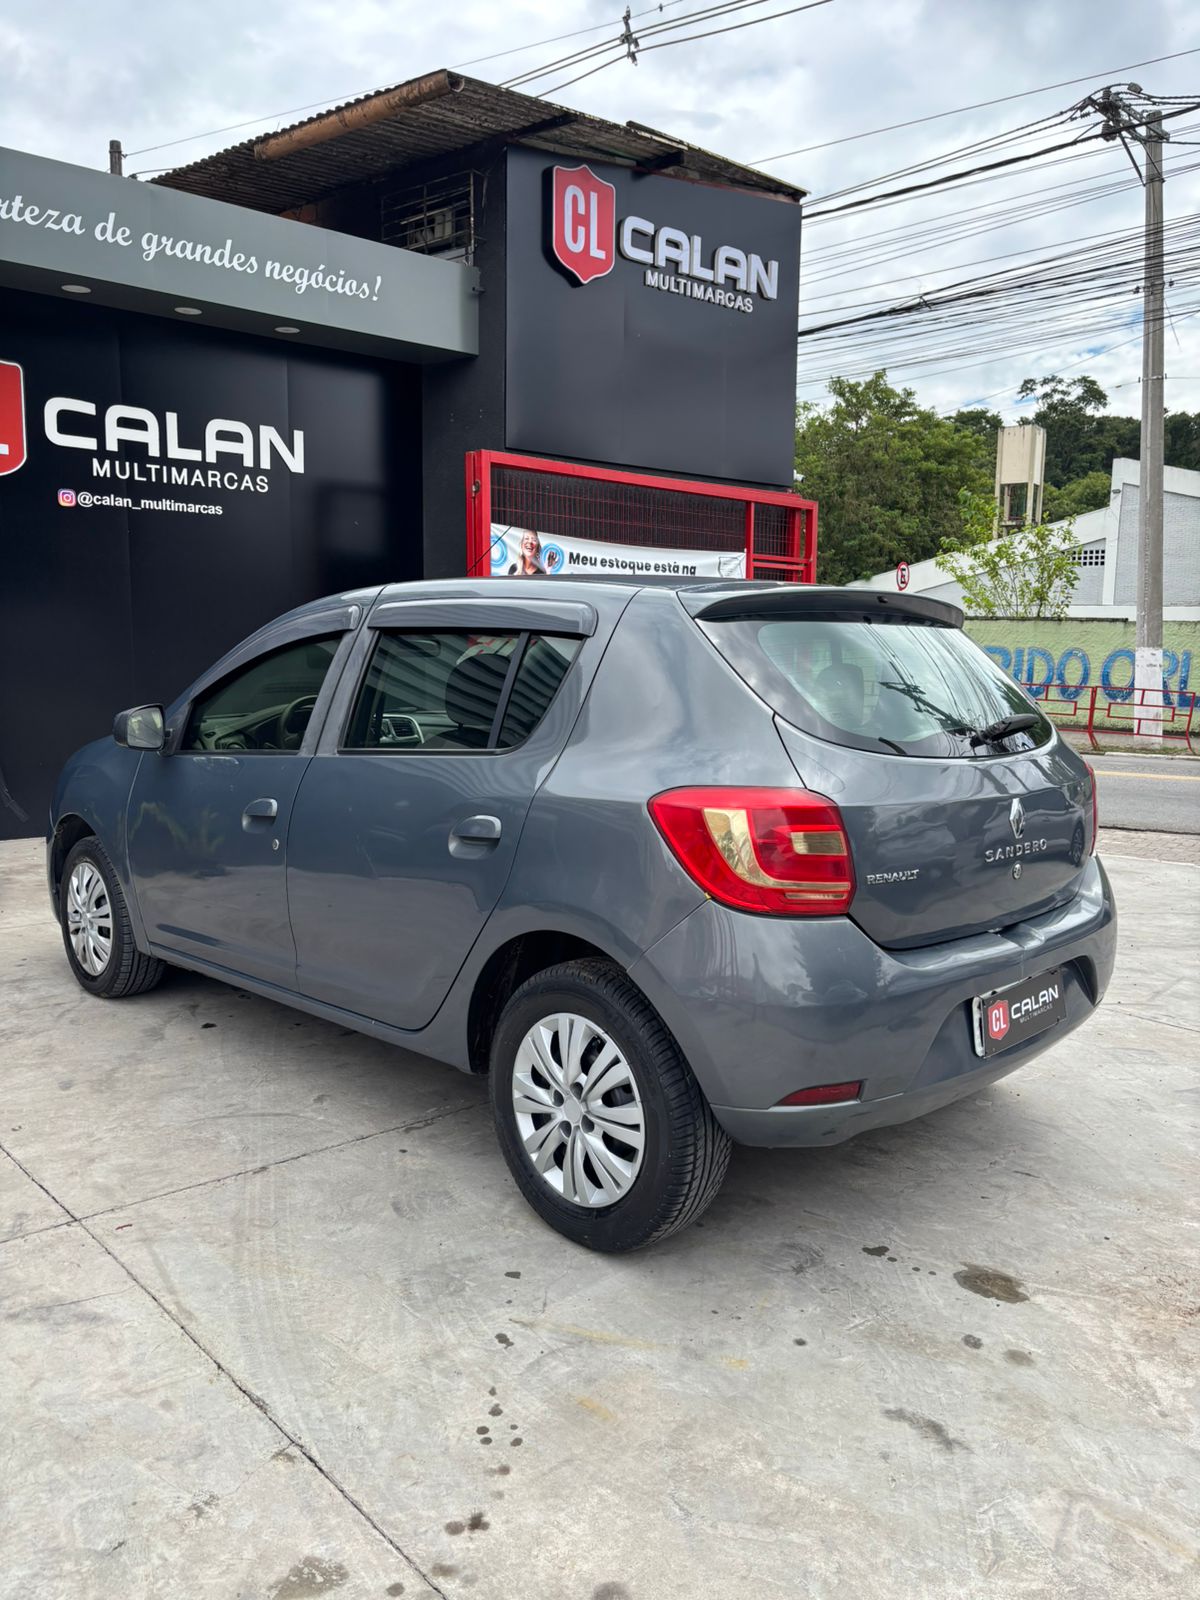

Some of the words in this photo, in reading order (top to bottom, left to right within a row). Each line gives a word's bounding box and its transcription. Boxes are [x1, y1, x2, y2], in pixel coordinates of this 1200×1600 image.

[564, 185, 606, 260] CL
[94, 212, 132, 247] de
[141, 231, 259, 274] grandes
[264, 259, 383, 301] negócios!
[620, 215, 779, 300] CALAN
[645, 269, 753, 313] MULTIMARCAS
[44, 397, 305, 474] CALAN
[92, 457, 269, 493] MULTIMARCAS
[77, 491, 223, 515] @calan_multimarcas
[568, 552, 598, 567] Meu
[600, 557, 651, 575] estoque
[653, 561, 679, 574] está
[985, 838, 1047, 863] SANDERO
[866, 869, 920, 885] RENAULT
[1010, 984, 1059, 1019] CALAN
[992, 1007, 1007, 1032] CL
